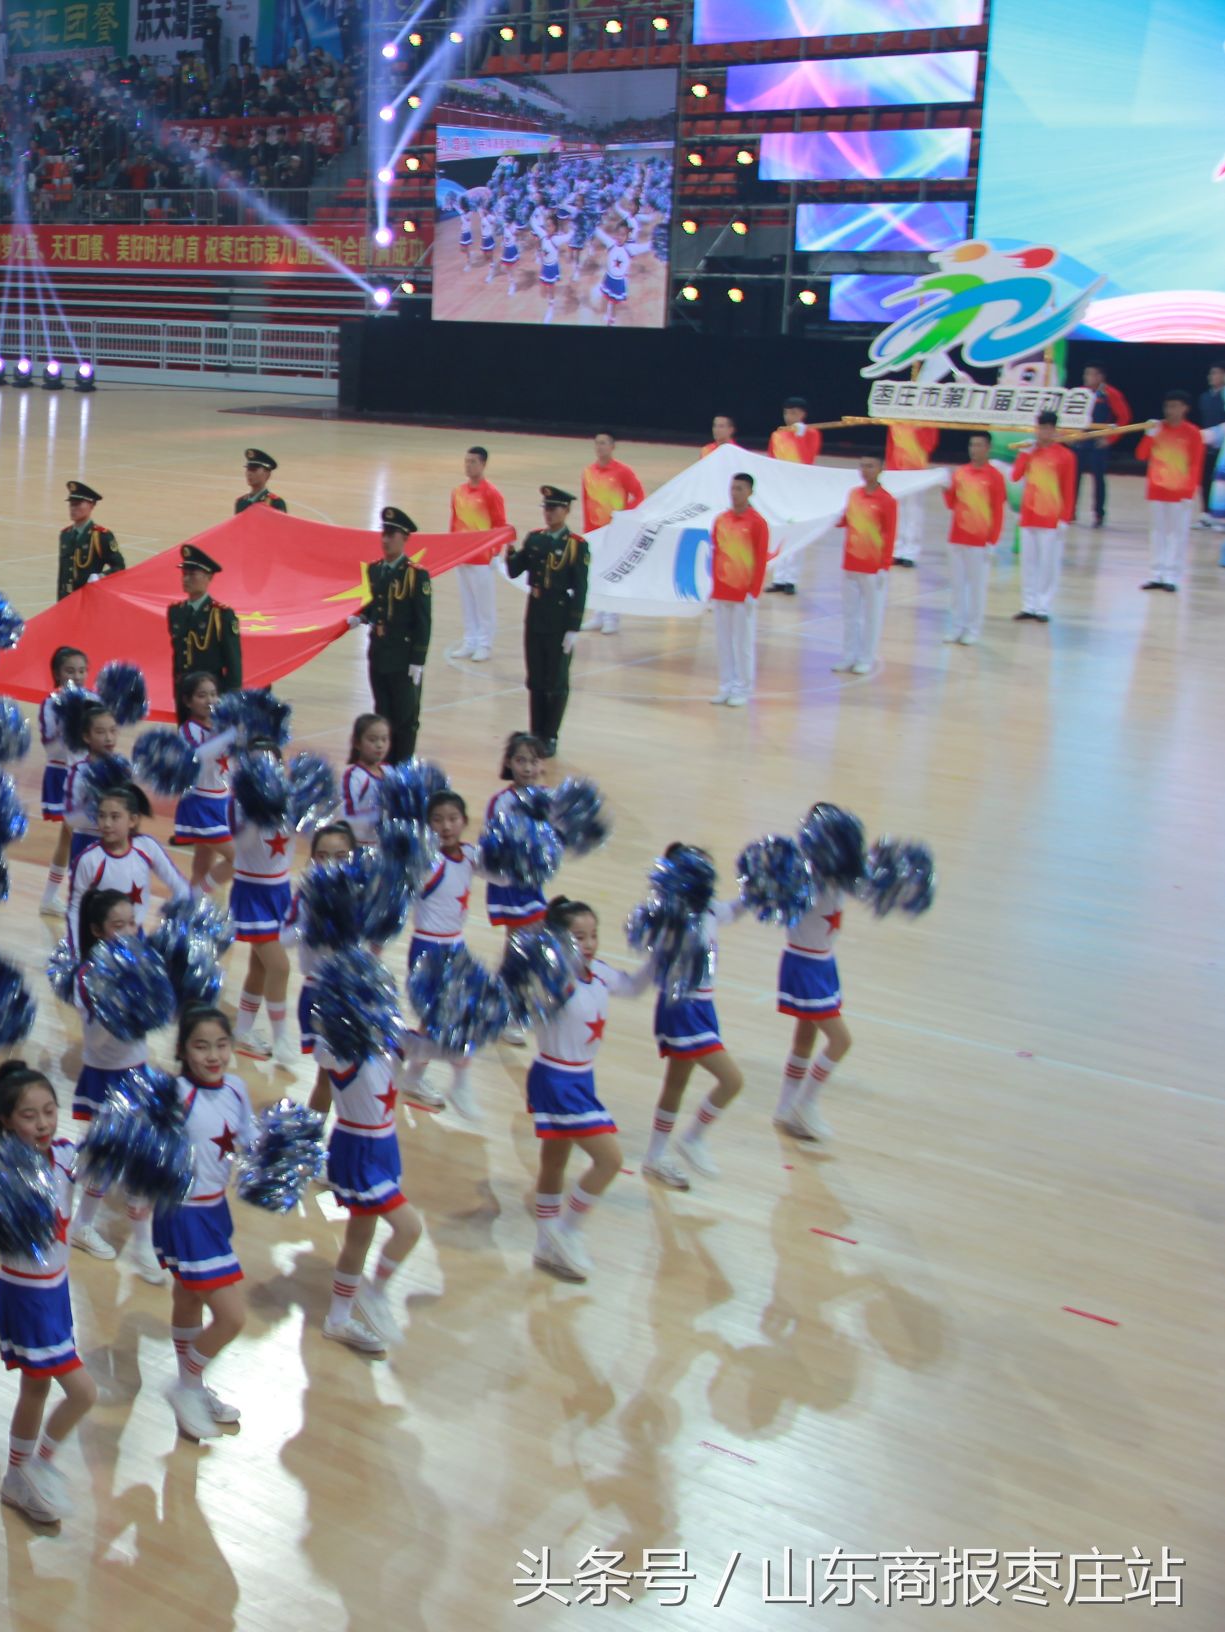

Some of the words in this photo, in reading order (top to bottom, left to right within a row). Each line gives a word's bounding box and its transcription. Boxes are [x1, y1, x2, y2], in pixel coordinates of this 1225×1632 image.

[8, 2, 120, 48] 天汇团餐
[872, 383, 1088, 415] 枣庄市第九届运动会
